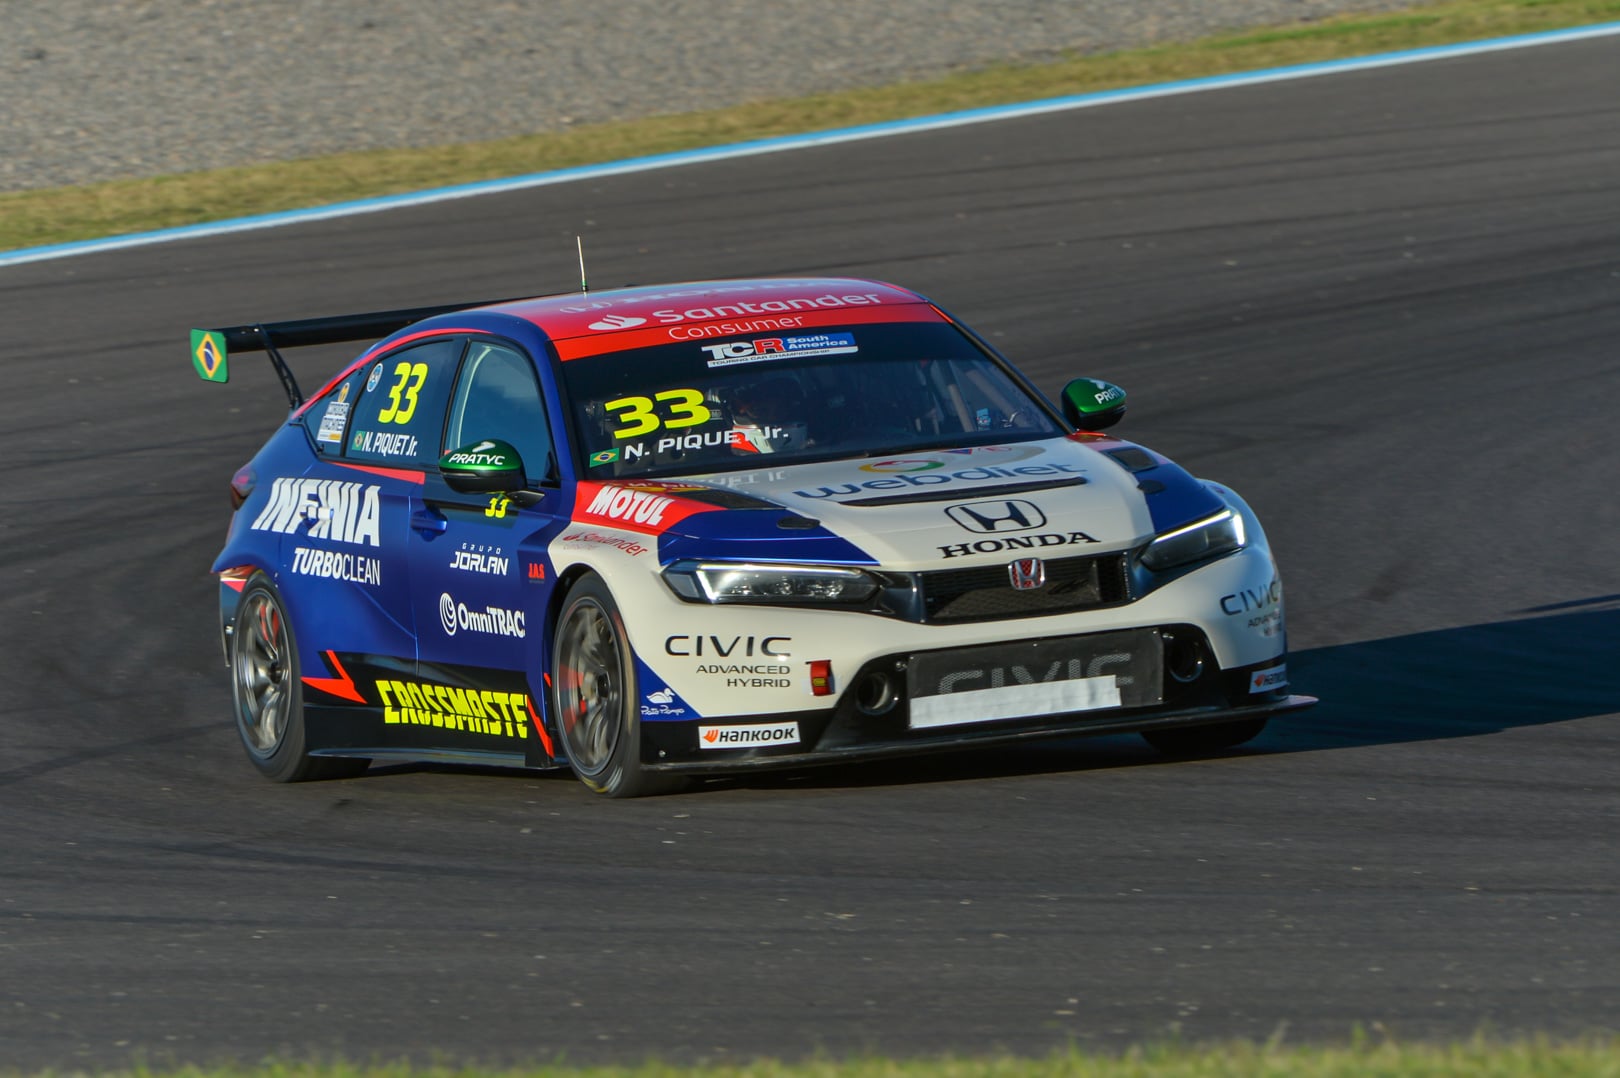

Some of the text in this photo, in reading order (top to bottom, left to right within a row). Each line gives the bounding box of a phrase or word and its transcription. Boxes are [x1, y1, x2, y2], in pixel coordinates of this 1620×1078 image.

[652, 293, 881, 323] Santander
[668, 316, 803, 340] Consumer
[787, 335, 829, 344] South
[701, 338, 785, 361] TCR
[788, 340, 848, 350] America
[711, 357, 749, 366] TOURING
[750, 354, 768, 362] CAR
[378, 362, 428, 425] 33
[604, 388, 711, 439] 33
[362, 431, 418, 457] N. PIQUET Jr.
[624, 426, 789, 460] N. PIQUET Jr.
[448, 453, 505, 466] PRATYC
[791, 463, 1088, 498] webdiet
[585, 485, 676, 526] MOTUL
[462, 543, 501, 555] GRUPO
[936, 531, 1101, 559] HONDA
[291, 547, 380, 586] TURBOCLEAN
[450, 551, 509, 576] JORLAN
[1219, 581, 1279, 616] CIVIC
[457, 602, 526, 638] OmniTRAC
[664, 635, 793, 657] CIVIC
[696, 665, 790, 675] ADVANCED
[727, 678, 791, 688] HYBRID
[375, 680, 528, 739] CROSSMASTE
